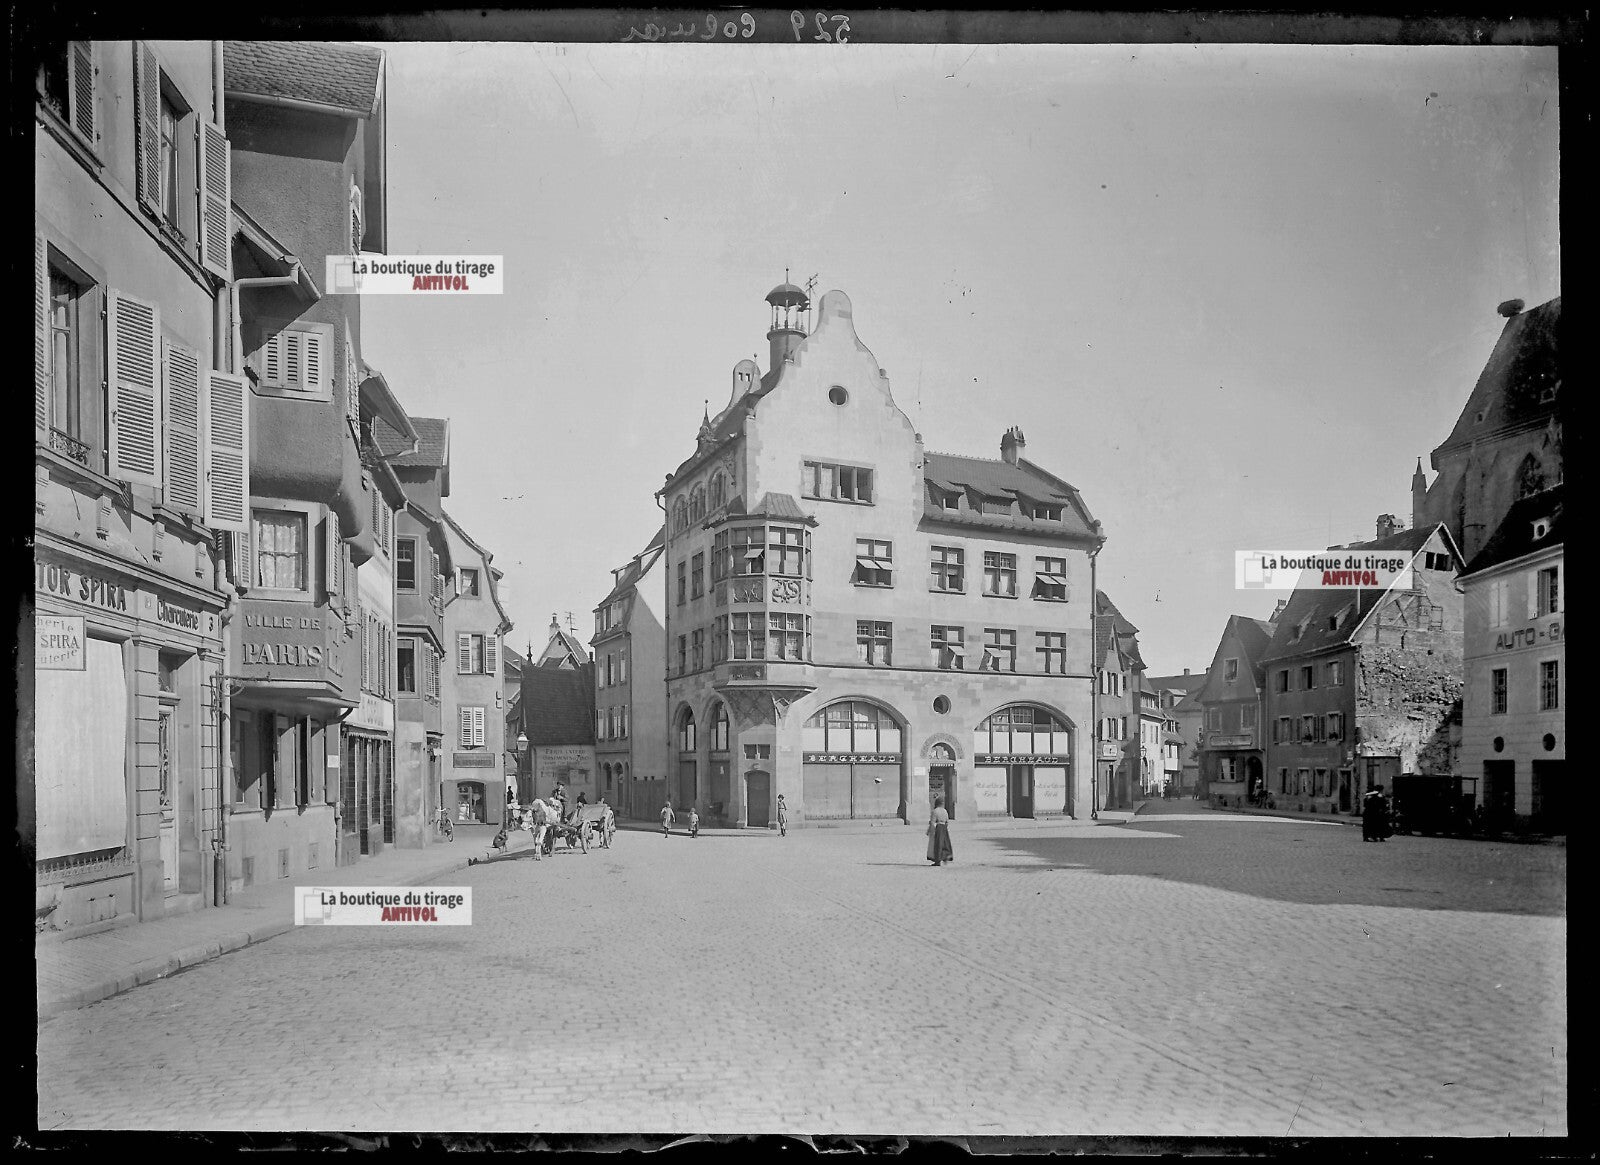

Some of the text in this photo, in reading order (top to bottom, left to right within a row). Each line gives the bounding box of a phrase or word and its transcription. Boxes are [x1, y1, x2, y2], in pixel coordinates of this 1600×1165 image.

[79, 574, 126, 612] SPIRA
[157, 600, 199, 630] Charcuterie
[245, 615, 321, 630] VILLE DE
[208, 616, 214, 632] 3
[40, 634, 80, 649] SPIRA
[243, 643, 323, 667] PARIS
[808, 754, 896, 762] BERGHEAUD
